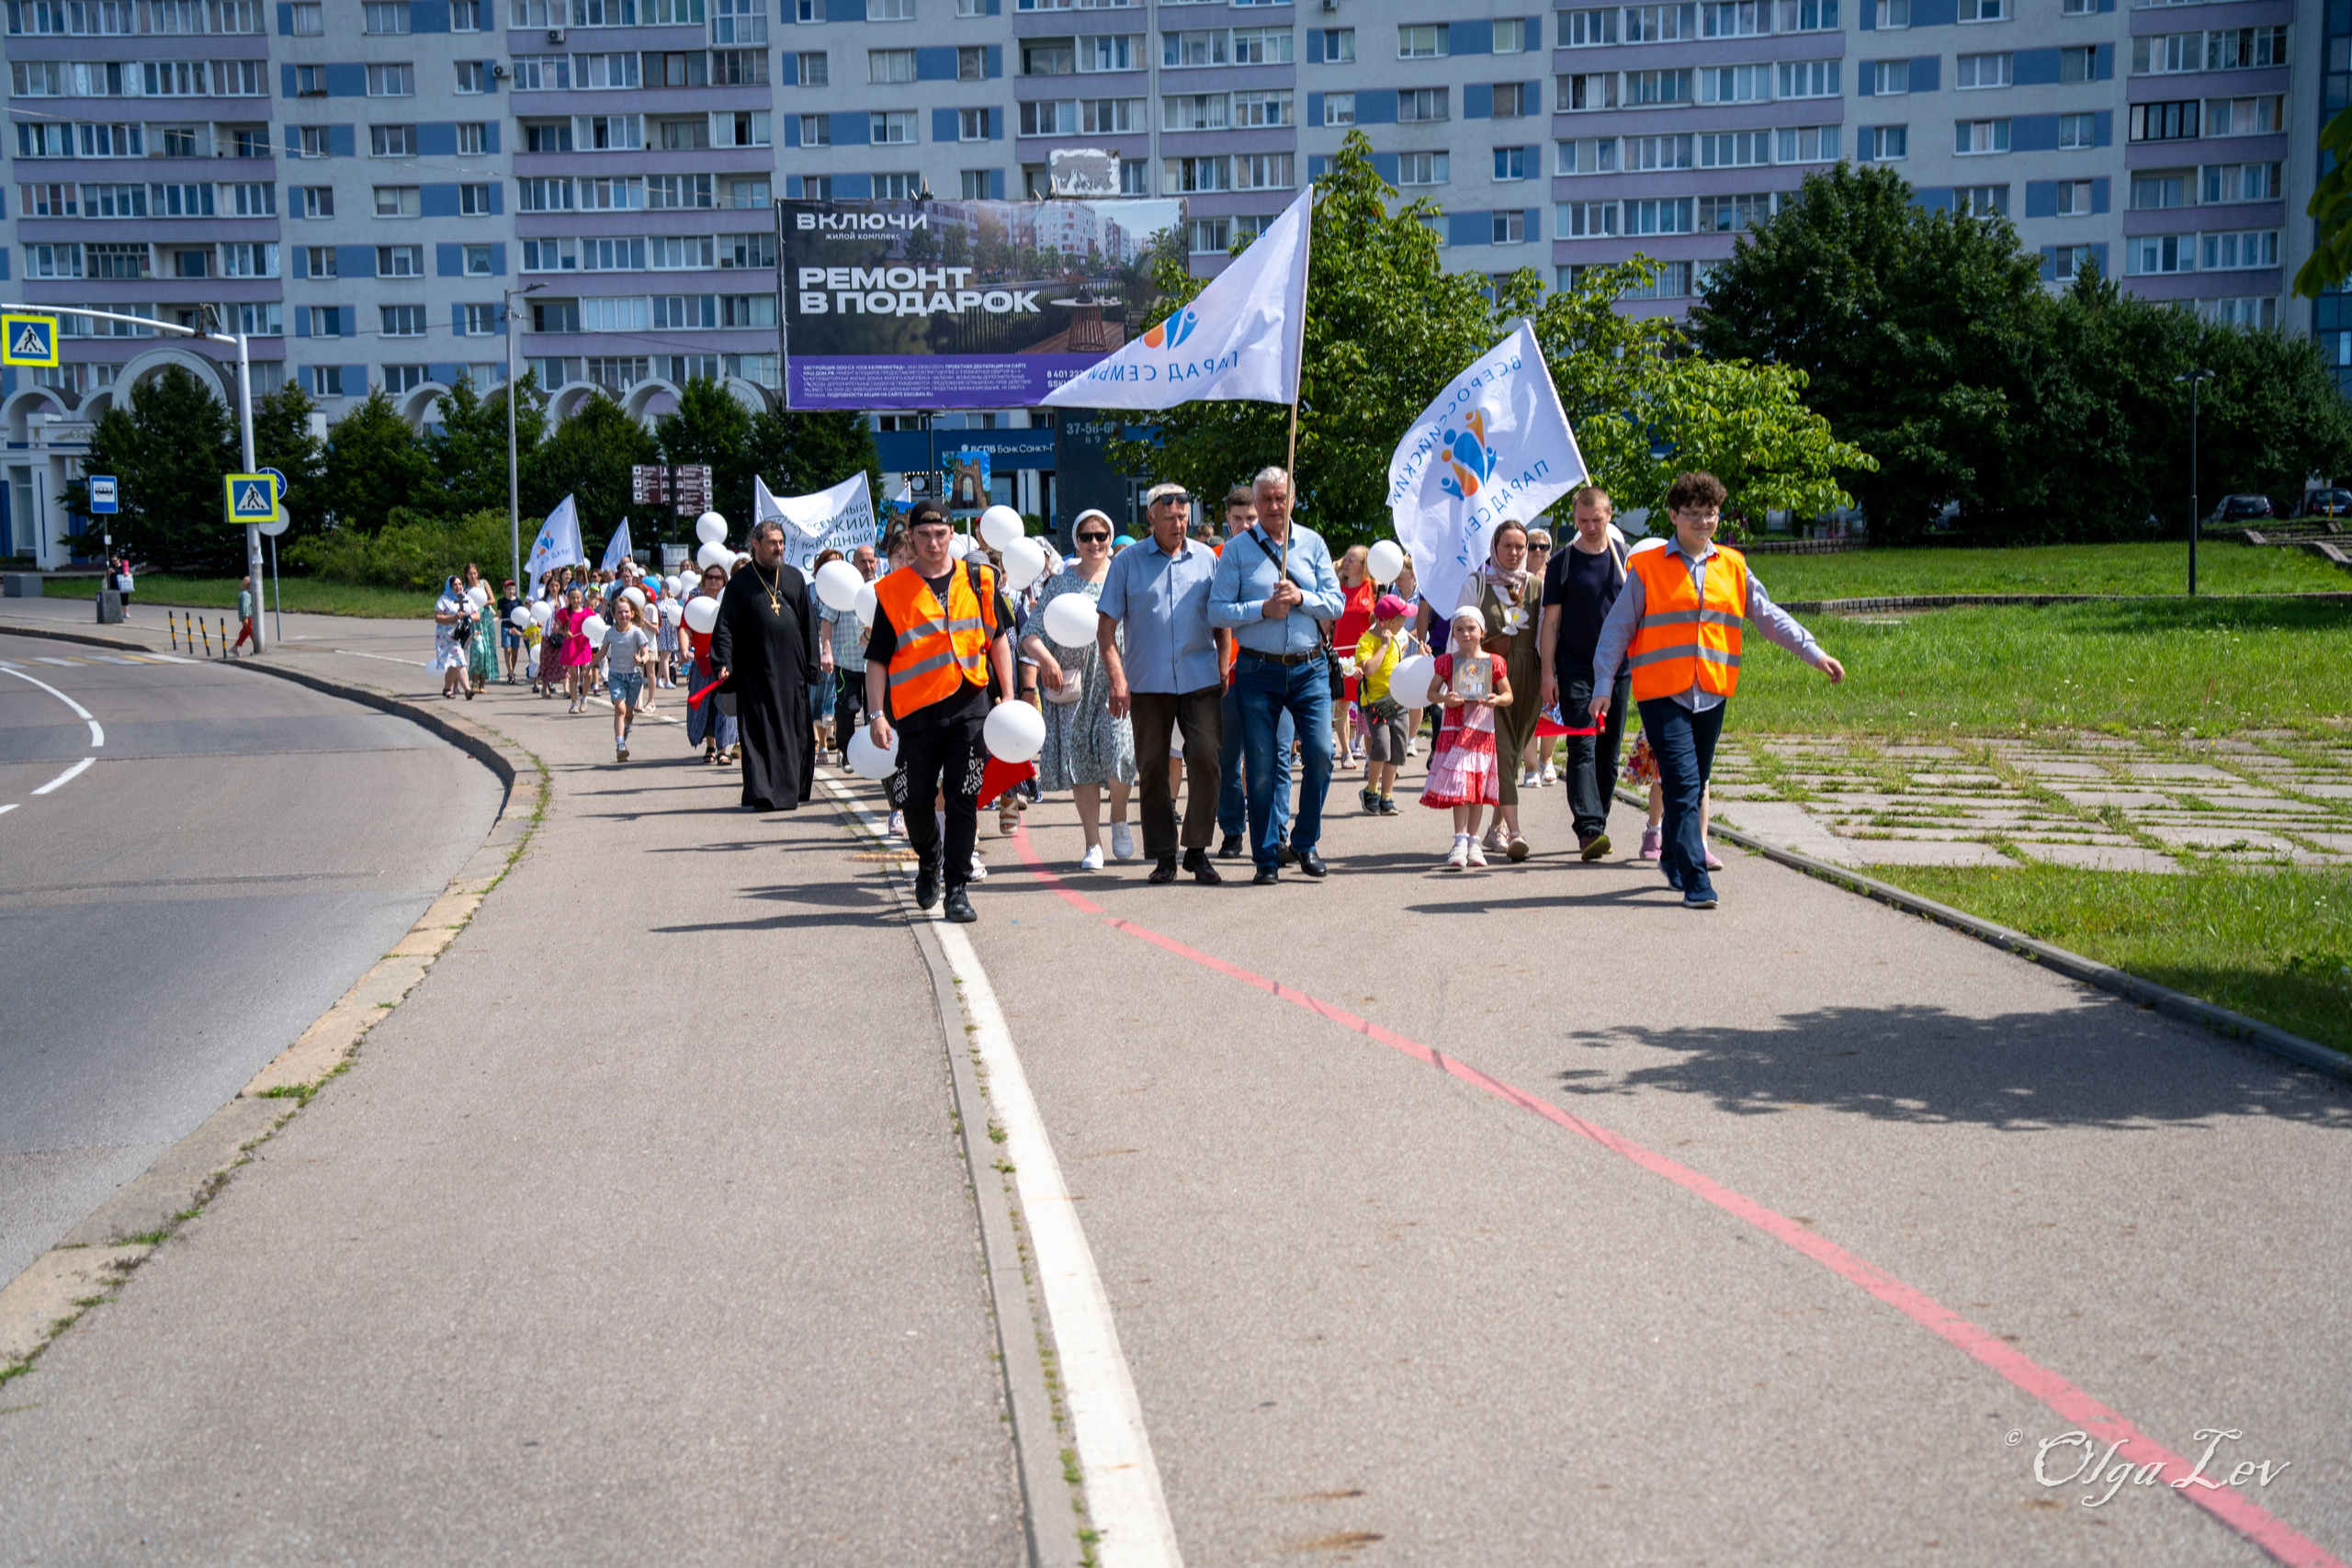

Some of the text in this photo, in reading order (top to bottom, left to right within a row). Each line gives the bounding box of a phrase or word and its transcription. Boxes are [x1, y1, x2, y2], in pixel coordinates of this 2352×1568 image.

[797, 213, 928, 230] ВКЛЮЧИ
[825, 231, 855, 241] жилой
[798, 266, 972, 289] РЕМОНТ
[799, 290, 1042, 318] В ПОДАРОК
[1054, 369, 1068, 378] 401
[997, 444, 1018, 454] Банк
